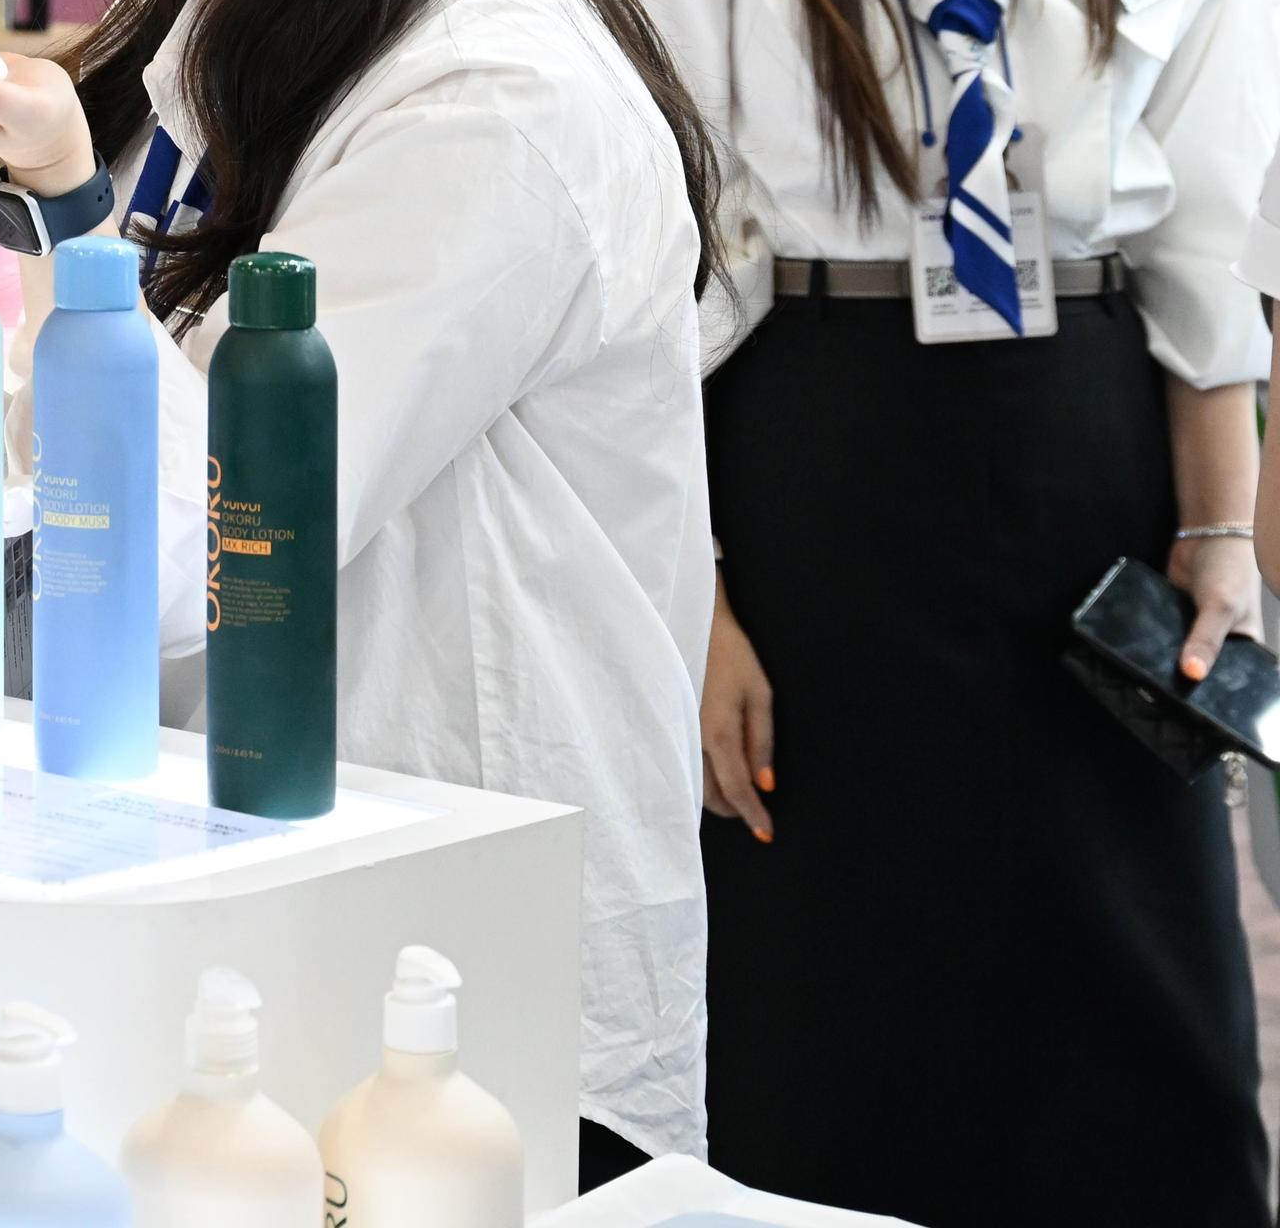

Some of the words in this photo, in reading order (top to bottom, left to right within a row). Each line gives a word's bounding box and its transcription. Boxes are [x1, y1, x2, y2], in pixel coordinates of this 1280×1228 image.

[42, 475, 79, 487] VUIVUI
[43, 487, 79, 501] OKORU
[69, 502, 111, 515] LOTION
[222, 500, 262, 513] VUIVUI
[79, 515, 109, 527] MUSK
[222, 512, 262, 527] OKORU
[222, 525, 249, 539] BODY
[252, 529, 296, 541] LOTION
[223, 539, 239, 551] MX
[241, 541, 269, 554] RICH
